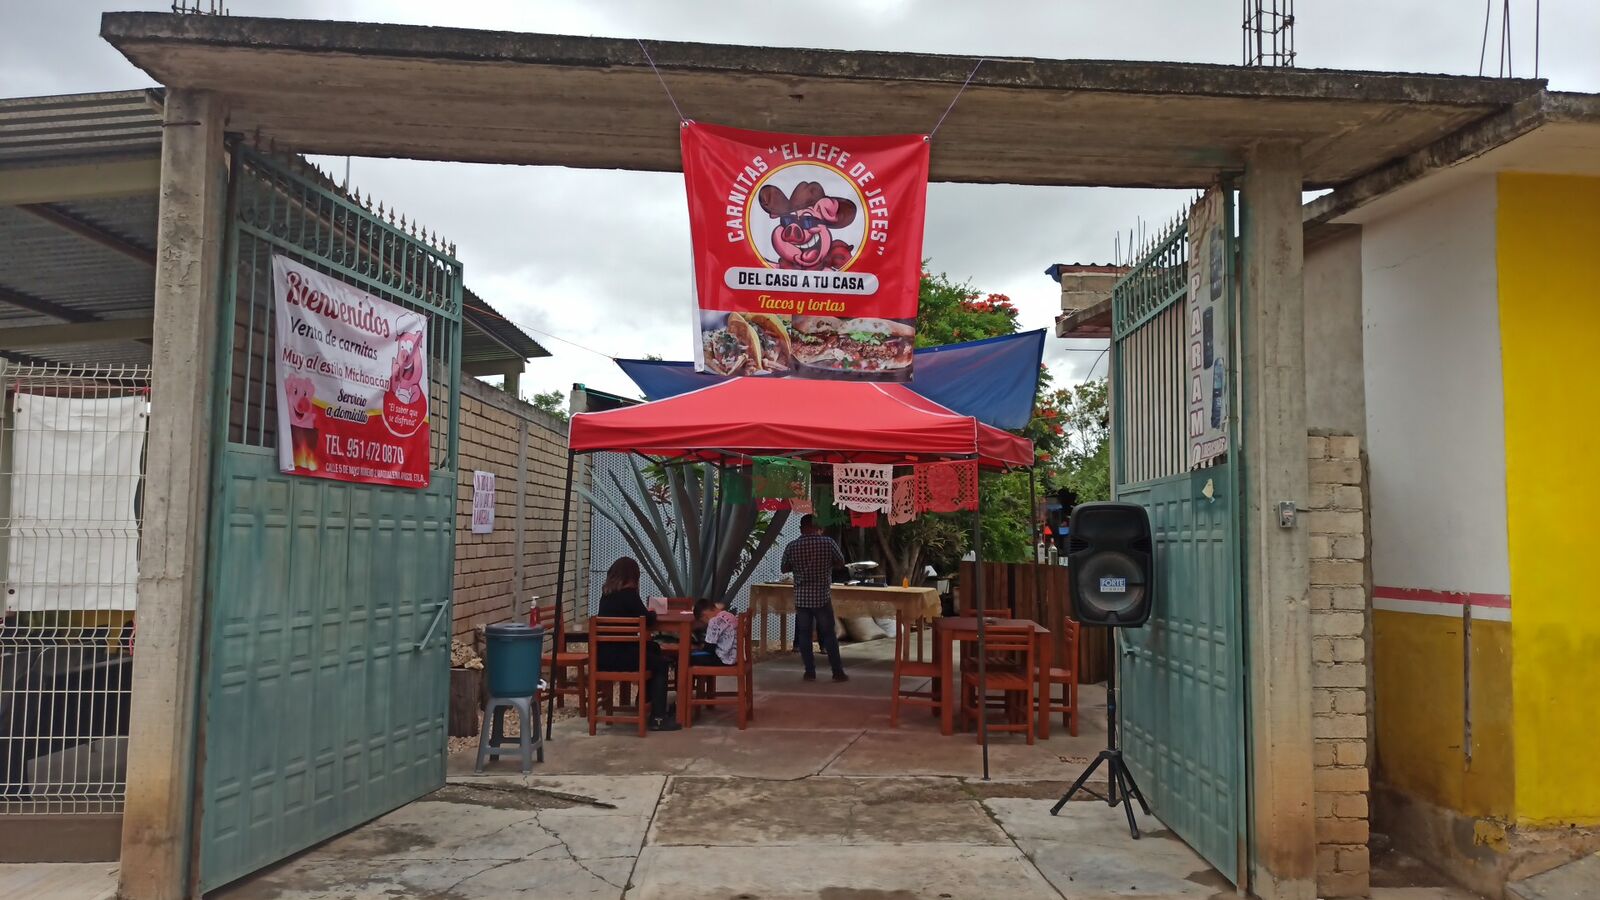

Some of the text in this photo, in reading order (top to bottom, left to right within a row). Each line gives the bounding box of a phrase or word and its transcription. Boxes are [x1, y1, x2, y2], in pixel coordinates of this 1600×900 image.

[726, 155, 769, 243] CARNITAS
[807, 142, 852, 168] JEFE
[849, 162, 875, 187] DE
[738, 271, 865, 290] DEL CASO A TU CASA
[286, 271, 390, 339] Bienvenidos
[758, 295, 846, 314] Tacos y tortas
[290, 316, 378, 361] Venta de carnitas
[282, 347, 390, 390] Muy al estilo Michoacán
[337, 389, 367, 406] Servicio
[326, 407, 368, 423] a domicilio
[325, 434, 344, 456] TEL.
[382, 444, 404, 464] 0870
[845, 468, 882, 479] VIVA
[840, 484, 887, 497] MEXICO
